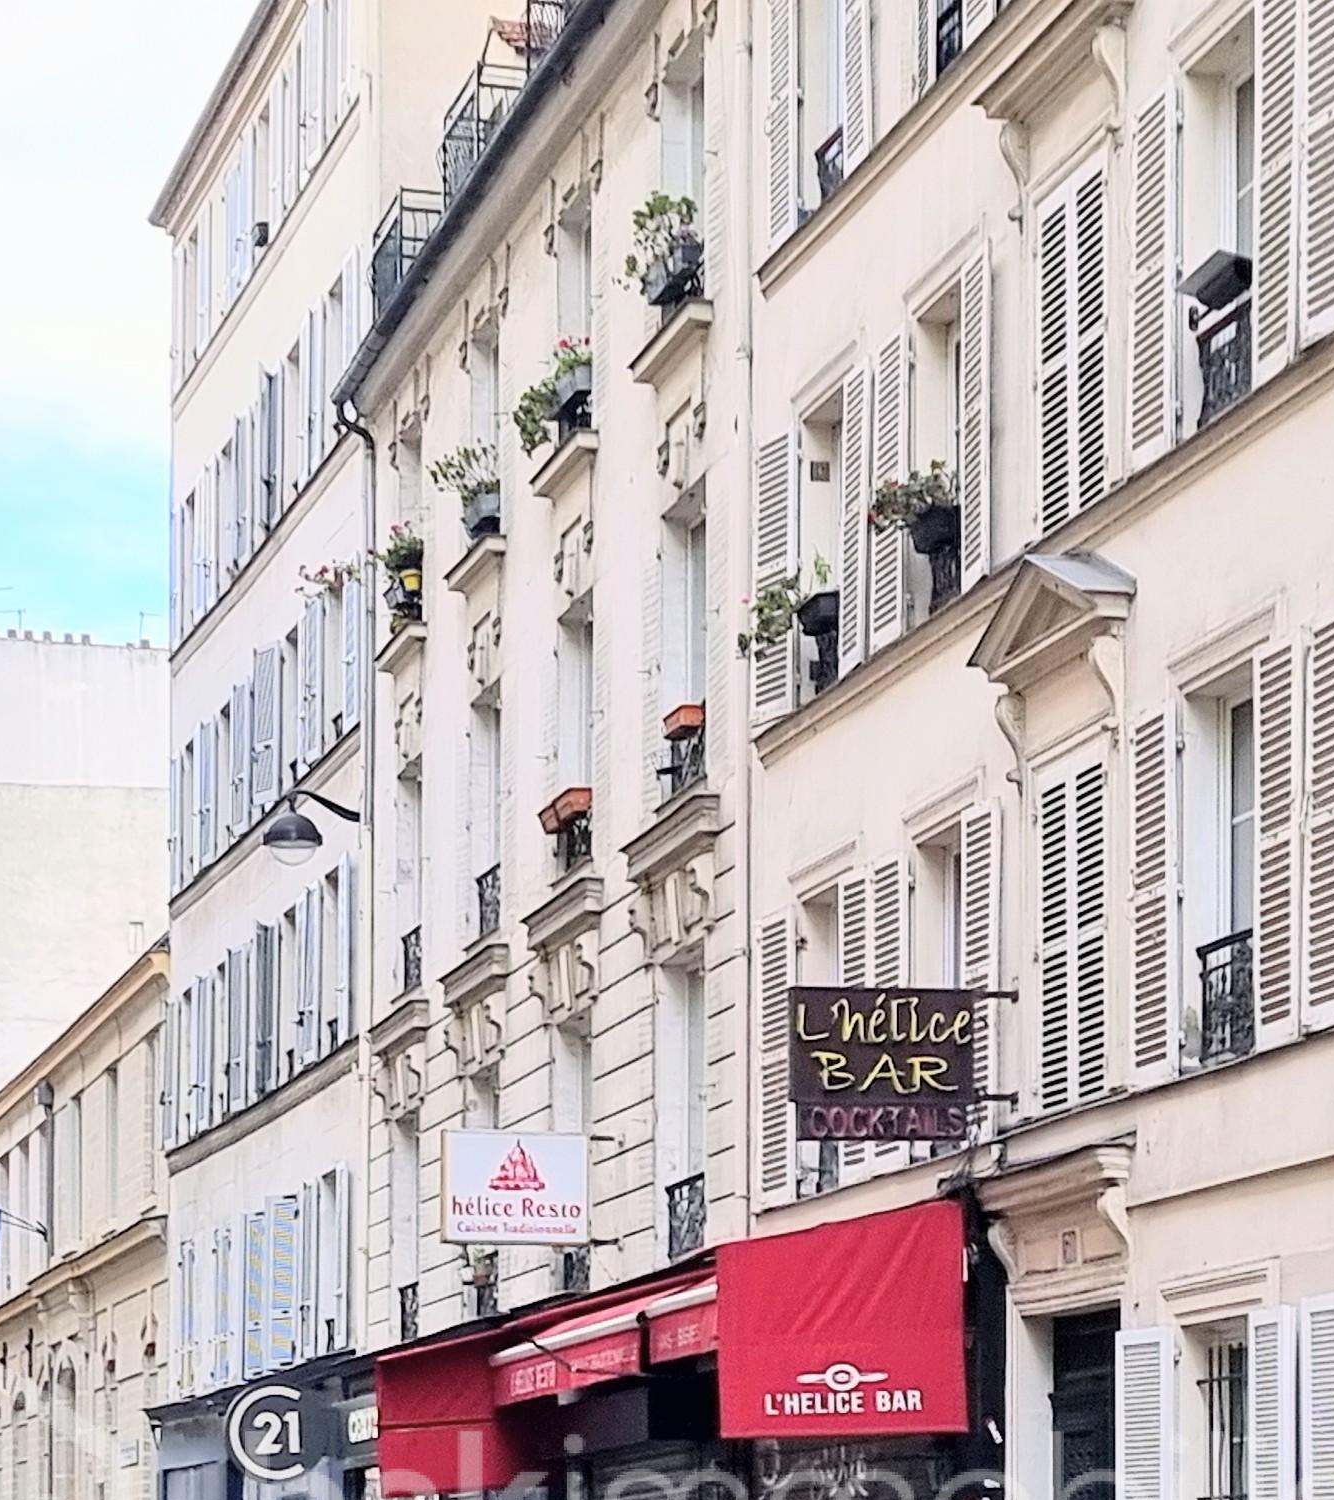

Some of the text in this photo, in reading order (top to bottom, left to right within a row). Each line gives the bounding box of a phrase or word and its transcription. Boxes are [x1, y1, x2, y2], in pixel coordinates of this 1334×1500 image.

[811, 1051, 959, 1094] BAR
[810, 1106, 964, 1137] COCKTAILS
[452, 1195, 581, 1218] hélice Resto
[764, 1390, 923, 1416] L'HELICE BAR
